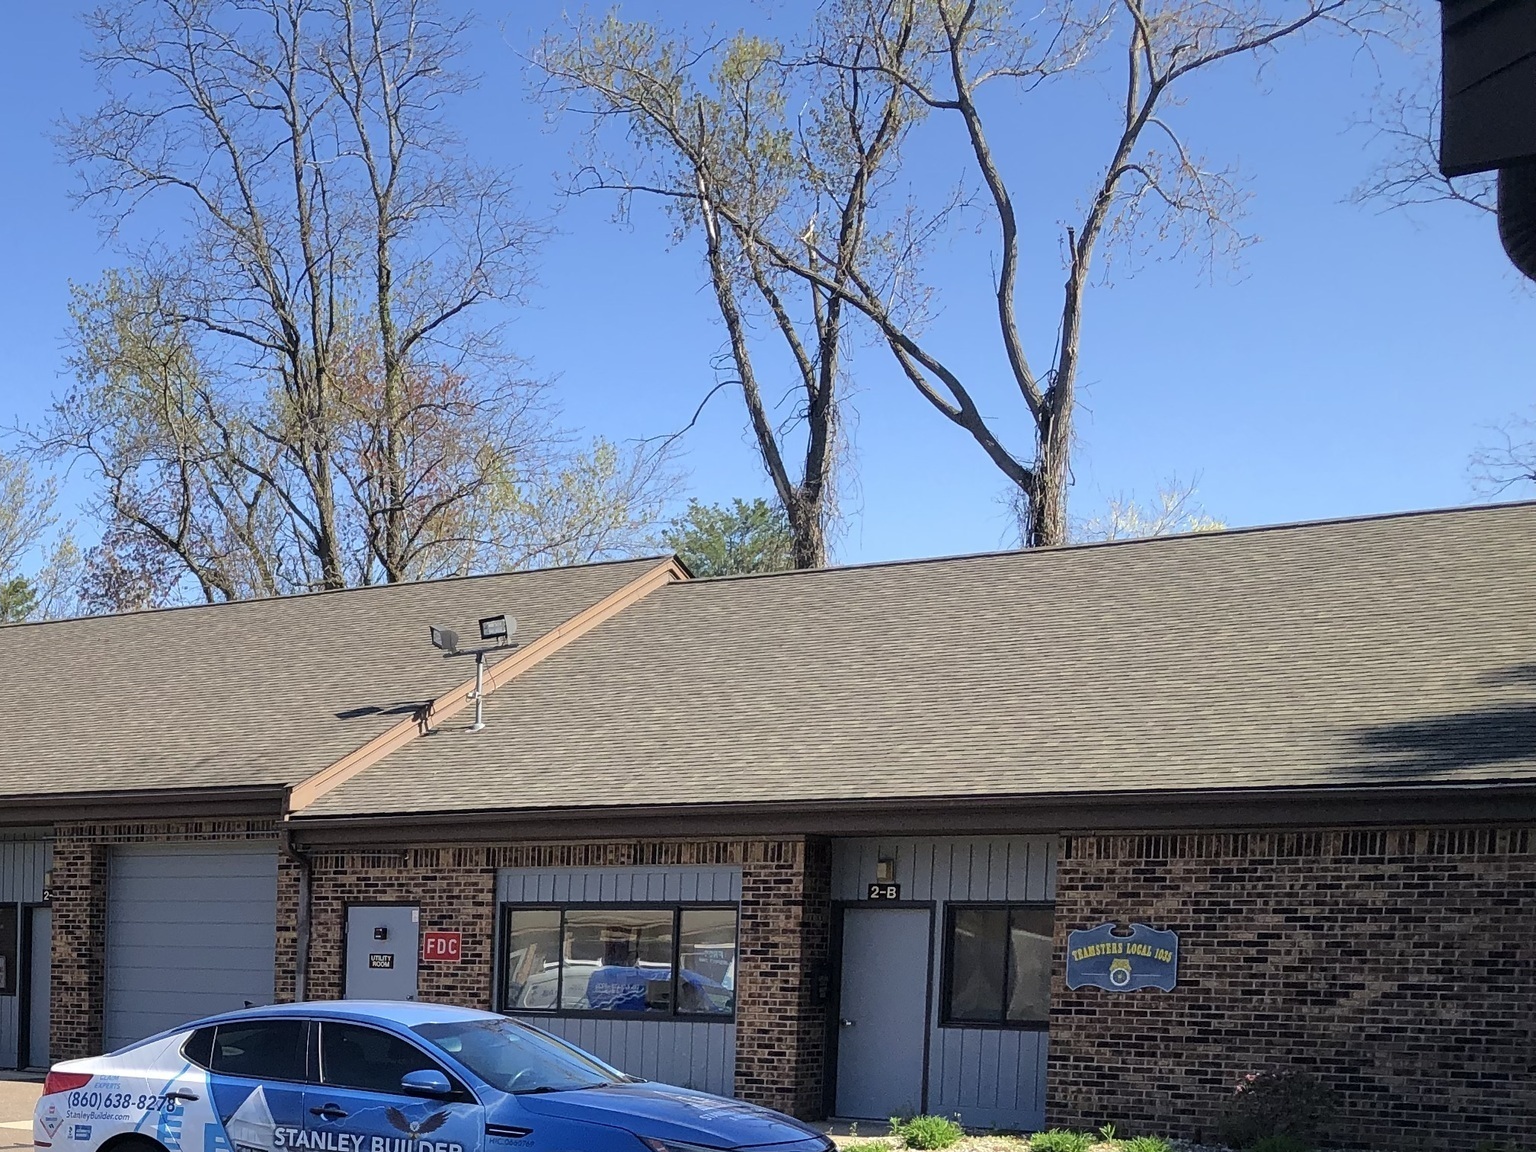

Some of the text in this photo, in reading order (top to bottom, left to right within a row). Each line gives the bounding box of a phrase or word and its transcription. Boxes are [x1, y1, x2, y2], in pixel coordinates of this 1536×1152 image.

[870, 885, 897, 899] 2-B
[426, 938, 457, 955] FDC
[1071, 942, 1123, 961] TEAMSTERS
[1126, 942, 1152, 957] LOCAL
[94, 1082, 121, 1090] EXPERTS
[67, 1091, 176, 1113] (860) 638-8278
[66, 1110, 130, 1121] StanleyBuilder.com
